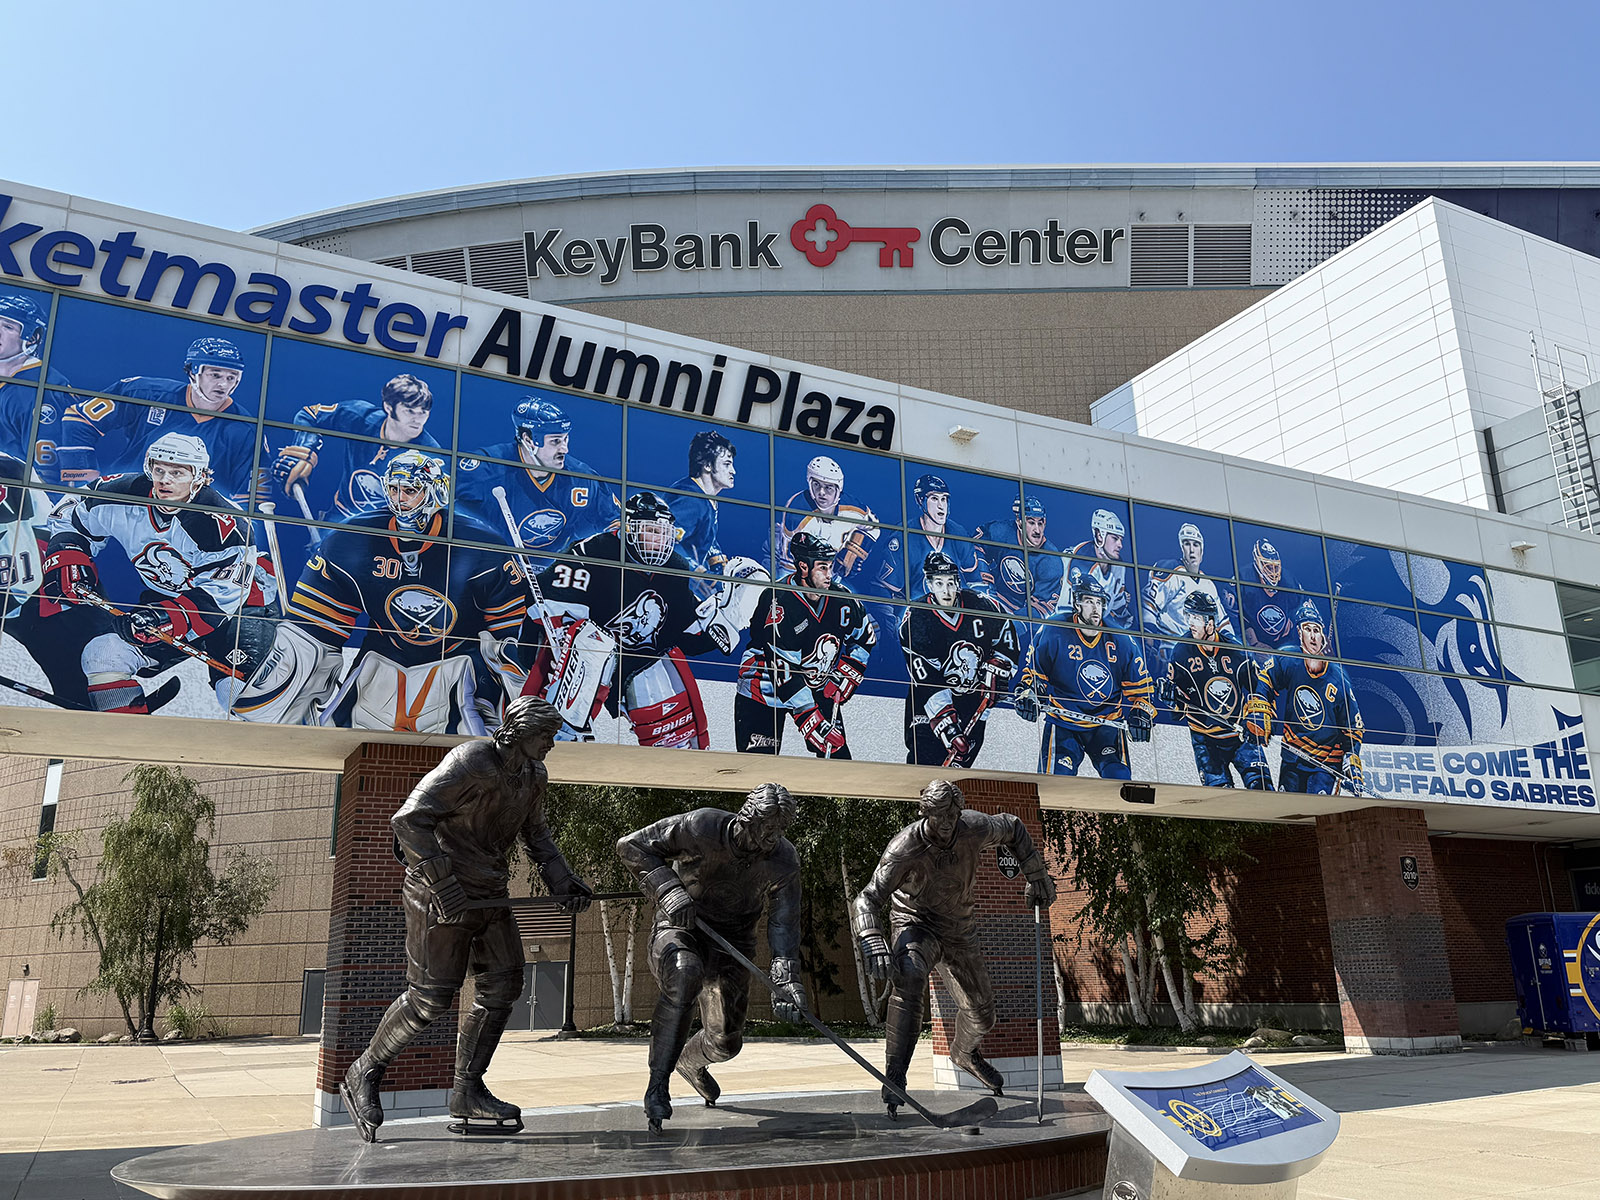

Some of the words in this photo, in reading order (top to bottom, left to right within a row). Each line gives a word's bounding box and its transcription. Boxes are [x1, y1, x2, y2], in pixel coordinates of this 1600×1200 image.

[523, 219, 782, 285] KeyBank
[929, 216, 1125, 267] Center
[0, 195, 468, 359] ketmaster
[469, 307, 725, 416] Alumni
[737, 364, 897, 450] Plaza
[571, 488, 589, 507] C
[0, 551, 35, 589] 81
[43, 554, 60, 574] PS
[372, 556, 400, 579] 30
[551, 564, 591, 592] 39
[840, 605, 851, 627] C
[973, 619, 985, 638] C
[1067, 644, 1083, 660] 23
[1105, 641, 1118, 662] C
[1187, 657, 1204, 673] 29
[1221, 655, 1234, 674] C
[1325, 682, 1339, 703] C
[652, 711, 694, 736] BAUER
[1442, 748, 1531, 778] COME
[1533, 732, 1591, 780] THE
[1491, 780, 1596, 808] SABRES
[1584, 882, 1600, 895] tick
